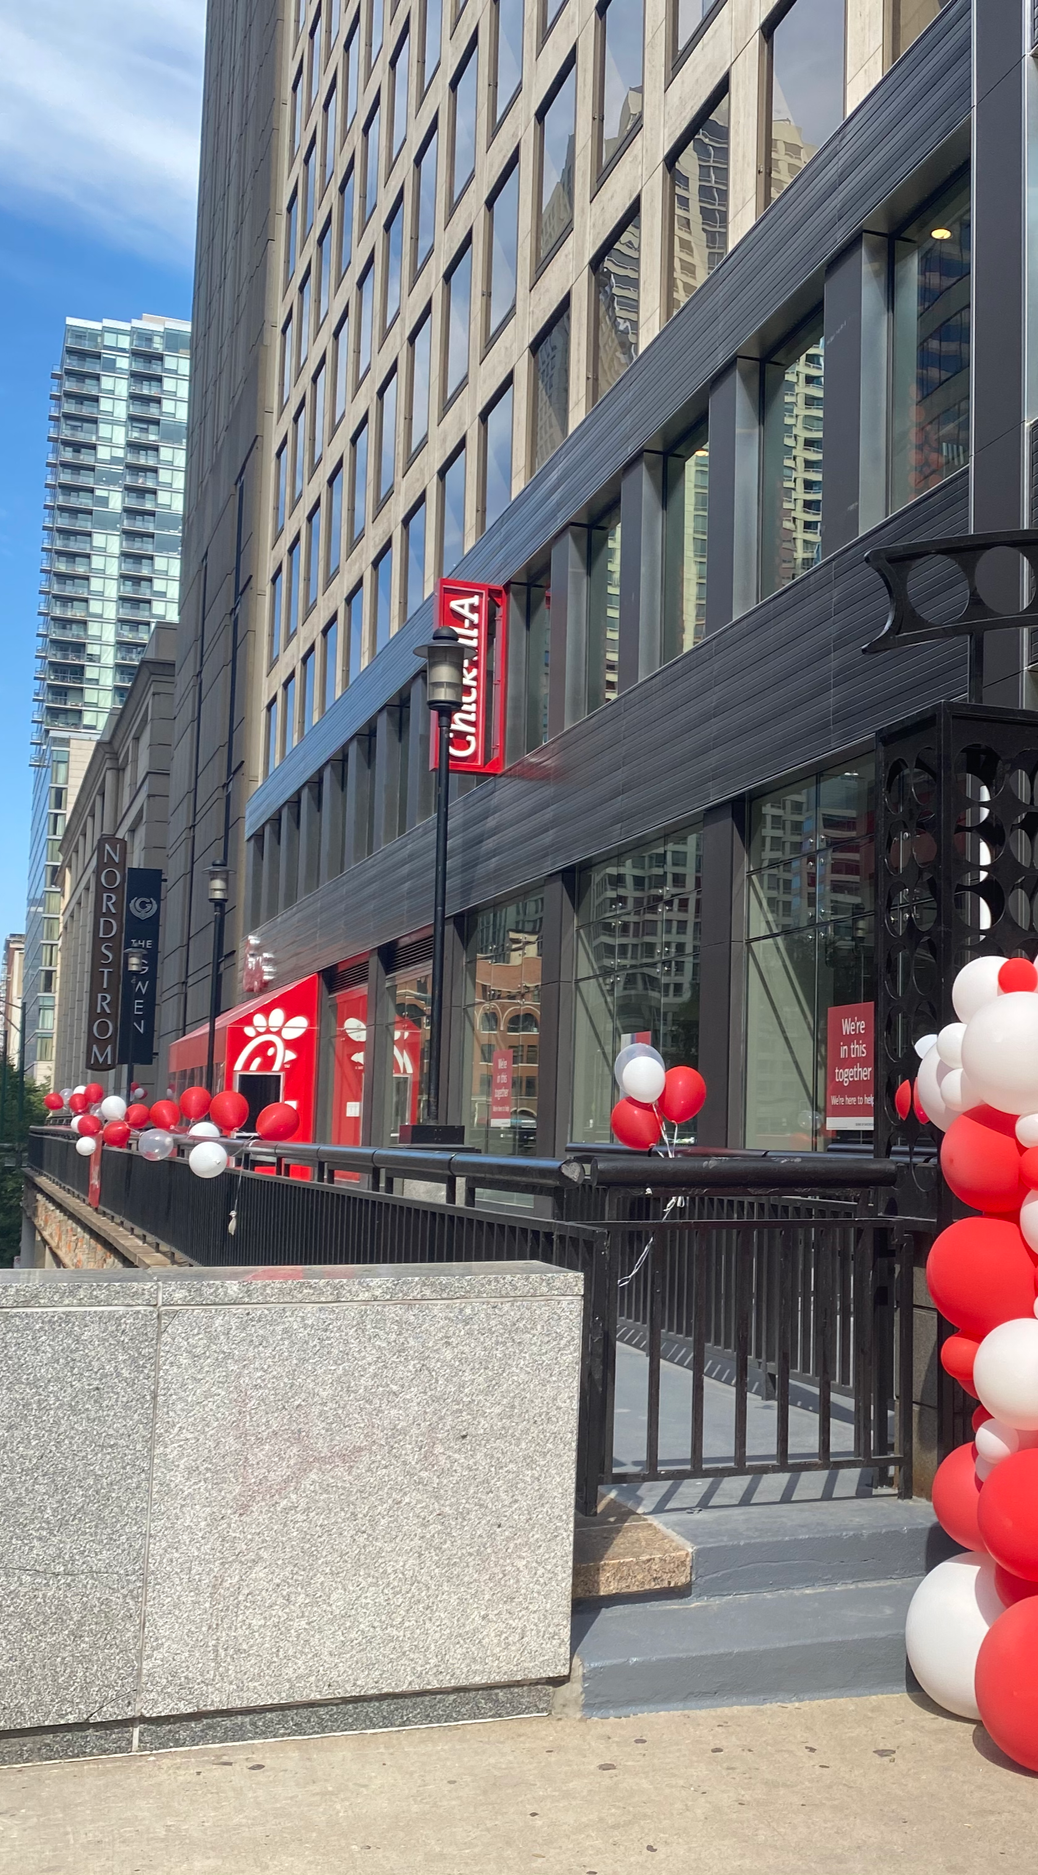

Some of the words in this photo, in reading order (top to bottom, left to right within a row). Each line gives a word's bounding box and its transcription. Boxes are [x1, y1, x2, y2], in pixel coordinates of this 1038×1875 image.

[131, 938, 153, 949] THE
[89, 843, 121, 1066] NORDSTROM
[842, 1017, 865, 1035] We're
[840, 1042, 848, 1058] in
[850, 1040, 867, 1058] this
[835, 1063, 872, 1086] together
[845, 1094, 857, 1105] here
[857, 1096, 864, 1105] to
